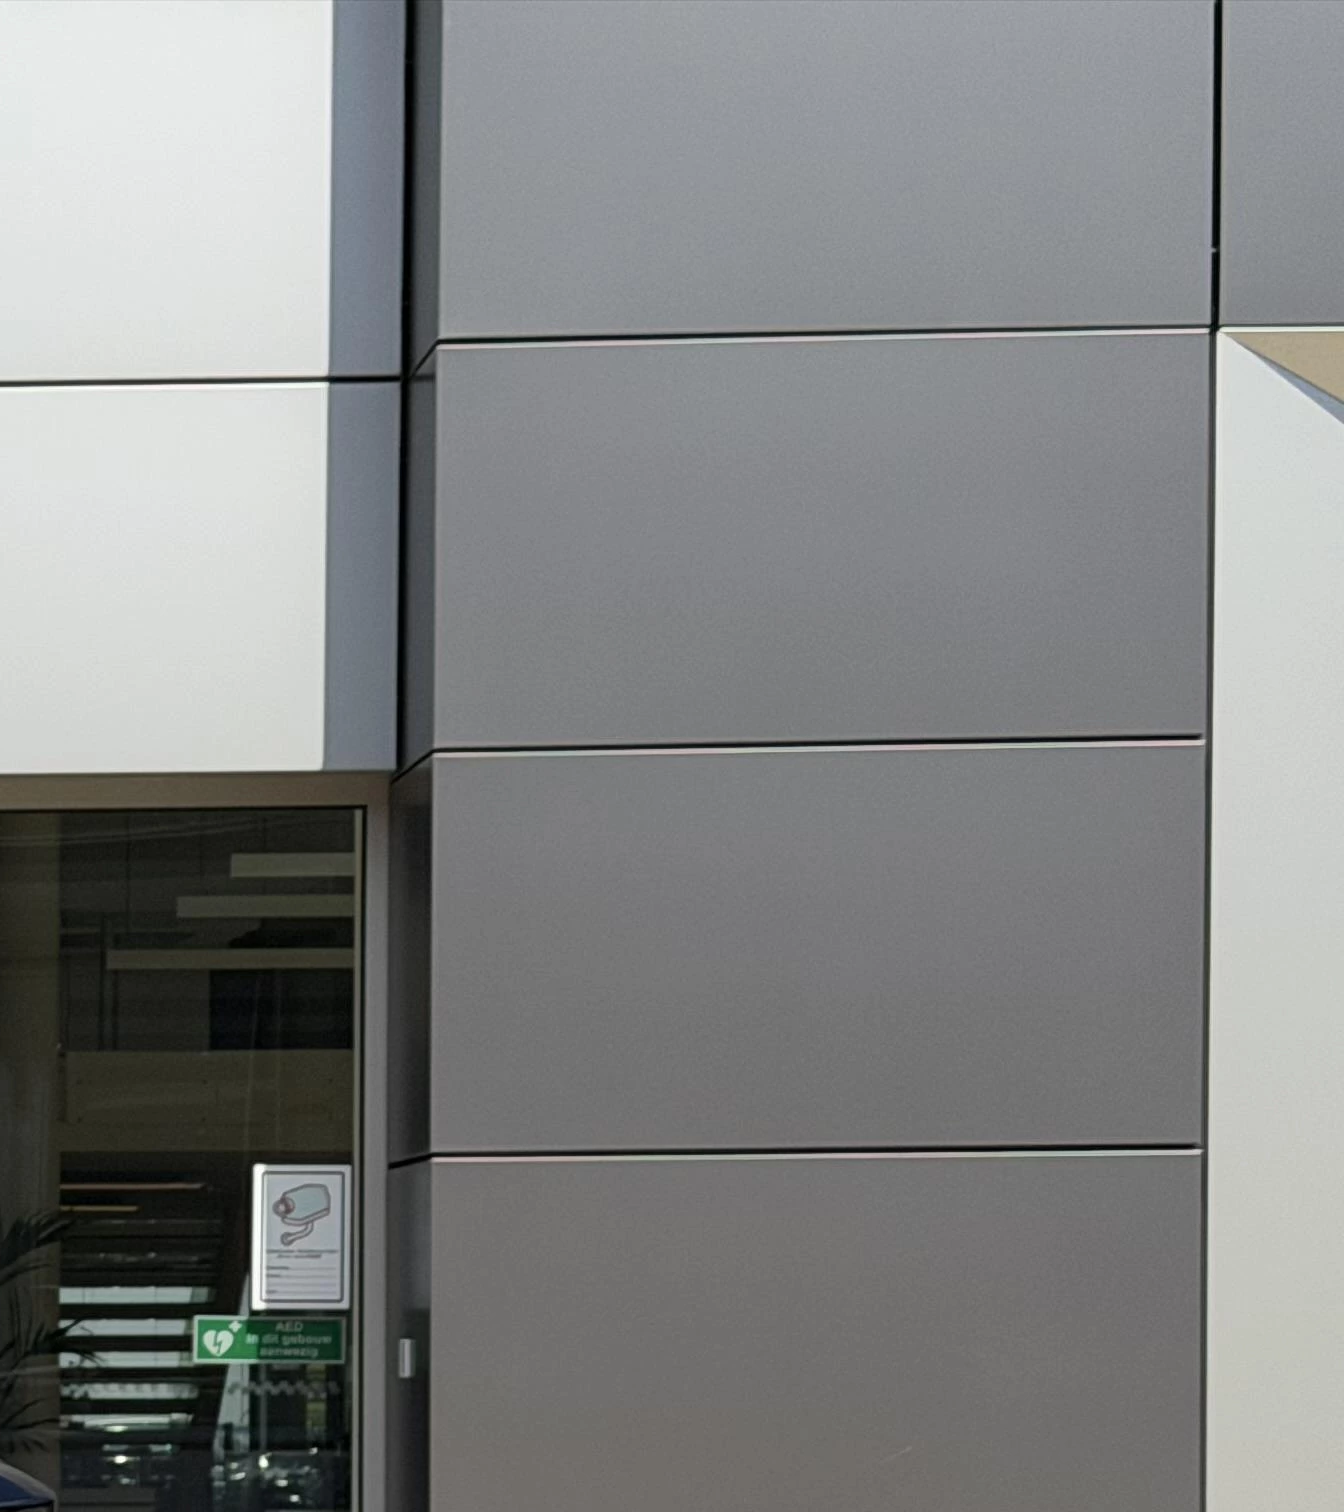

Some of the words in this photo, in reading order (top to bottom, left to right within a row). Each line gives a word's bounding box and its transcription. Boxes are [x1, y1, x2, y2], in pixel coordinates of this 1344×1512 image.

[275, 1321, 303, 1332] AED
[262, 1333, 279, 1344] dit
[281, 1333, 332, 1346] gebouw
